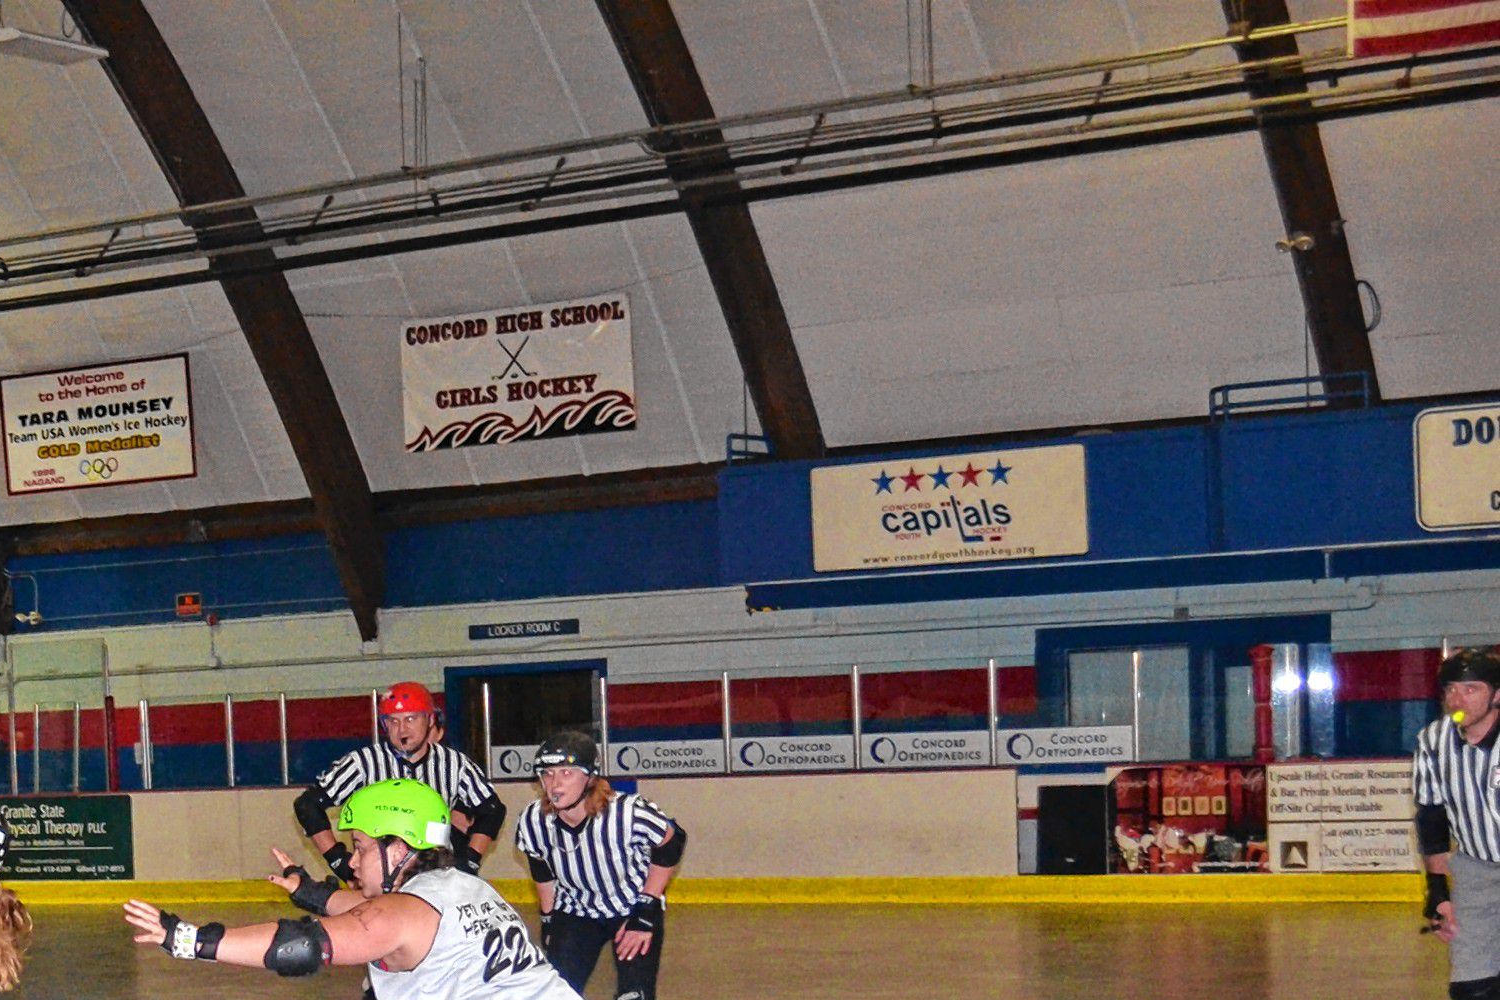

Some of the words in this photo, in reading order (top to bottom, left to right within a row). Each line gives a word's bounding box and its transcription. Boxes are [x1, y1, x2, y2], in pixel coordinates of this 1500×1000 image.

[406, 318, 488, 346] CONCORD
[495, 311, 543, 335] HIGH
[550, 301, 624, 328] SCHOOL
[57, 370, 124, 386] Welcome
[38, 392, 54, 403] to
[58, 387, 81, 400] the
[85, 382, 127, 397] Home
[131, 379, 146, 391] of
[435, 385, 498, 409] GIRLS
[506, 374, 597, 401] HOCKEY
[18, 410, 69, 427] TARA
[77, 396, 174, 421] MOUNSEY
[8, 431, 37, 443] Team
[41, 427, 65, 440] USA
[68, 421, 119, 437] Women's
[124, 418, 140, 431] Ice
[144, 413, 188, 428] Hockey
[1452, 416, 1500, 447] DO
[37, 442, 80, 459] GOLD
[85, 433, 161, 454] Medalist
[881, 502, 931, 513] CONCORD
[881, 495, 1012, 542] capitals
[488, 625, 524, 637] LOCKER
[526, 622, 551, 633] ROOM
[553, 621, 560, 633] C
[1367, 769, 1413, 779] Restauran
[1401, 787, 1413, 795] an
[1, 805, 36, 818] Granite
[40, 804, 65, 818] State
[44, 821, 84, 837] Therapy
